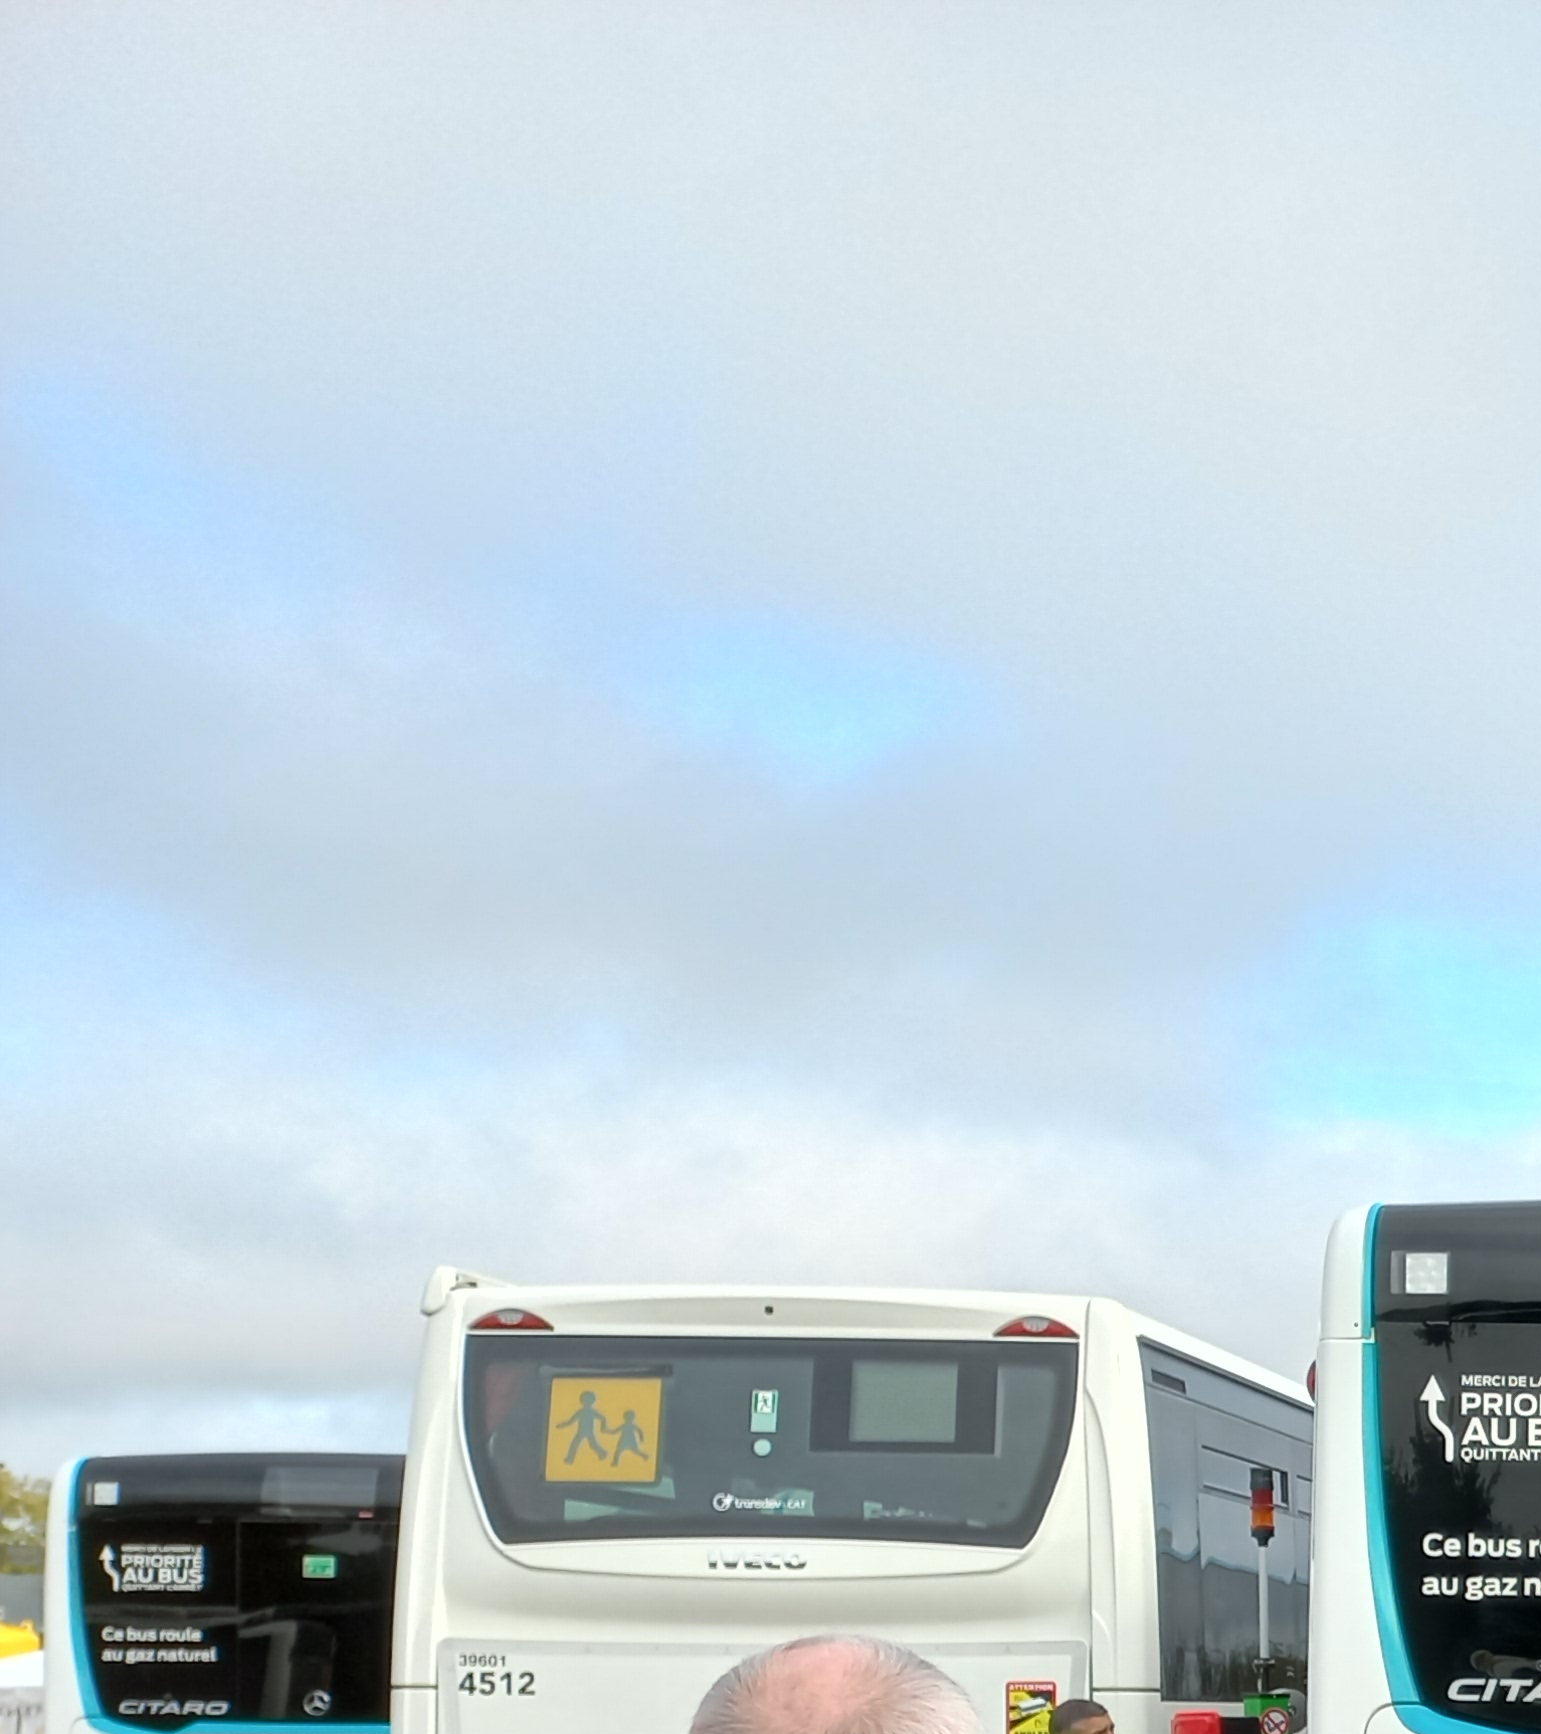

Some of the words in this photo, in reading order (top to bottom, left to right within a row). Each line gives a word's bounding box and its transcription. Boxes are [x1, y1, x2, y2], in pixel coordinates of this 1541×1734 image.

[1460, 1374, 1505, 1388] MERCI
[1508, 1375, 1527, 1388] DE
[1461, 1417, 1517, 1446] AU
[1460, 1448, 1541, 1463] QUITTANT
[1422, 1533, 1461, 1558] Ce
[1468, 1533, 1522, 1558] bus
[121, 1553, 204, 1568] PRIORITÉ
[707, 1552, 808, 1570] IVECO
[122, 1568, 153, 1584] AU
[158, 1569, 204, 1585] BUS
[1421, 1575, 1459, 1596] au
[1464, 1576, 1518, 1601] gaz
[102, 1627, 124, 1642] Ce
[127, 1627, 157, 1642] bus
[160, 1628, 204, 1643] roule
[102, 1651, 123, 1663] au
[126, 1652, 155, 1665] gaz
[157, 1648, 218, 1663] naturel
[459, 1655, 507, 1668] 39601
[459, 1672, 536, 1696] 4512
[118, 1700, 230, 1716] CITARO
